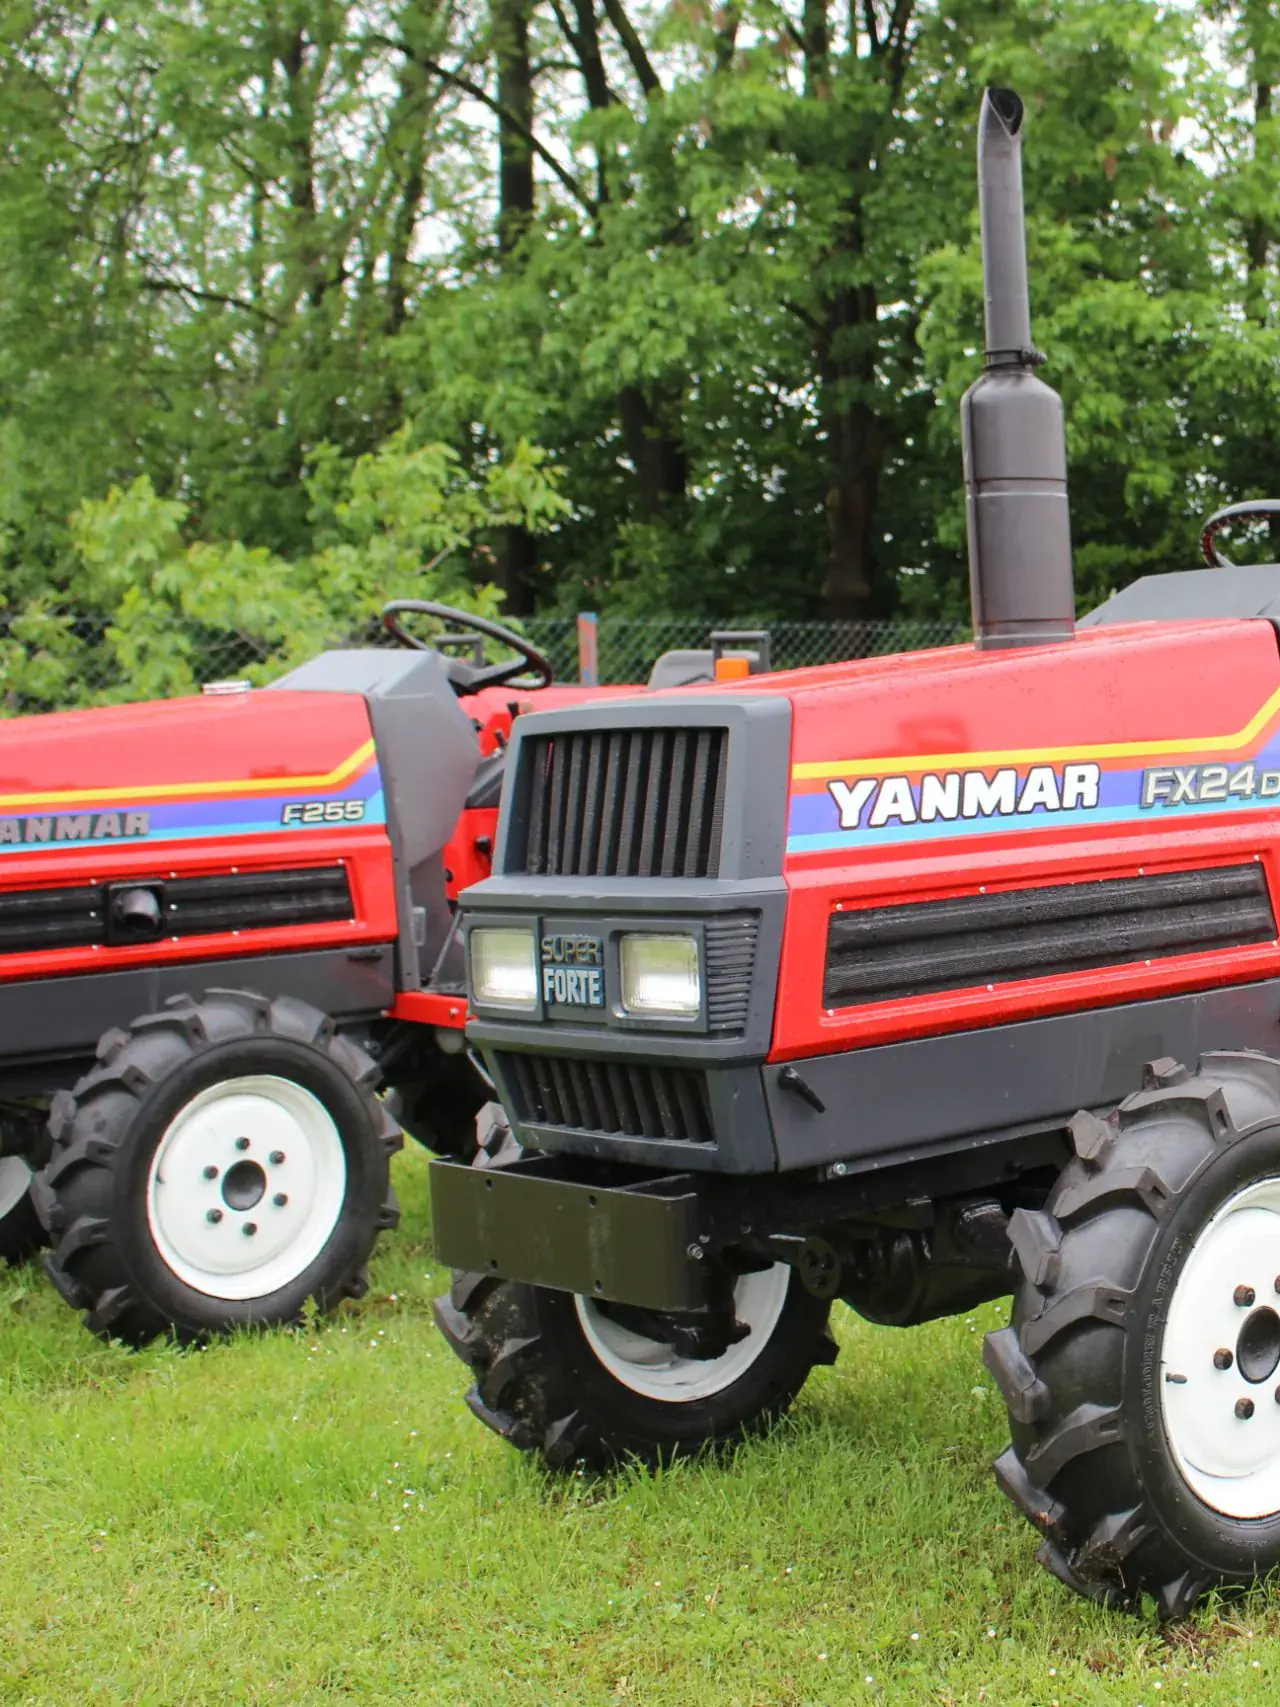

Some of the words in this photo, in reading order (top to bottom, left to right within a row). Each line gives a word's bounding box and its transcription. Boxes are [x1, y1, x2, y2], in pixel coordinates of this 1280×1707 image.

[282, 800, 365, 824] F255
[828, 764, 1099, 830] YANMAR
[541, 937, 599, 963] SUPER
[543, 968, 601, 1005] FORTE
